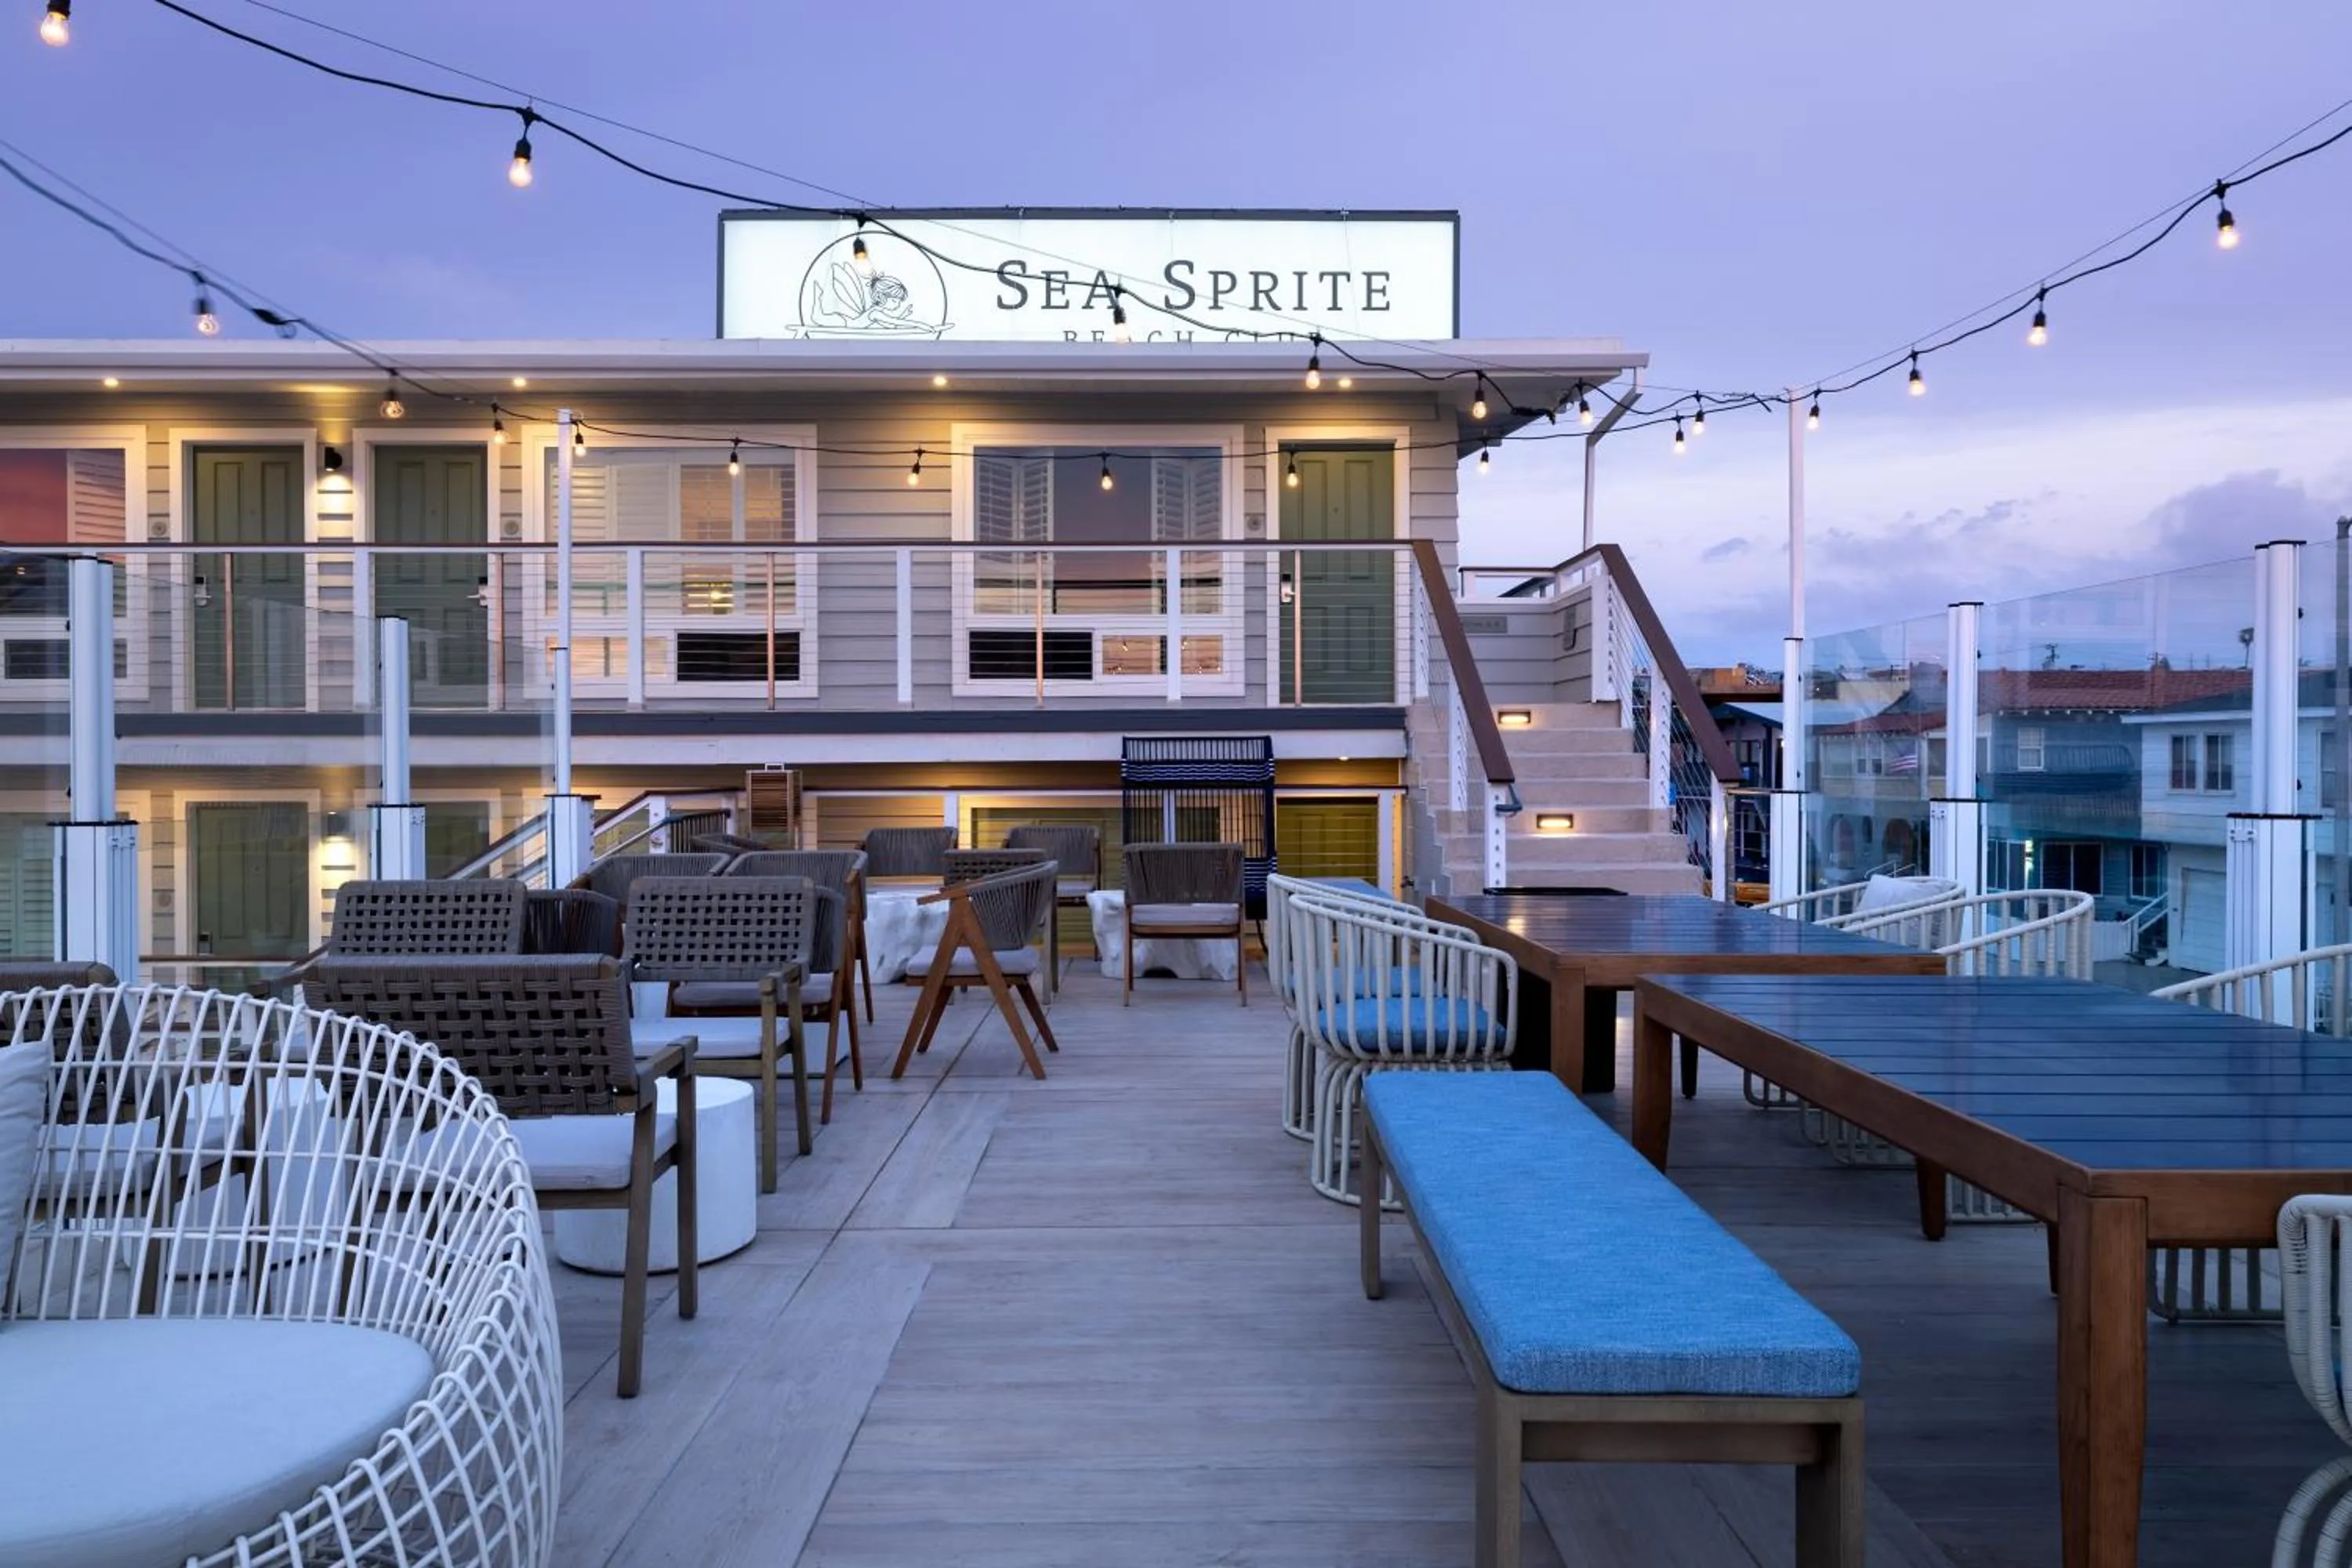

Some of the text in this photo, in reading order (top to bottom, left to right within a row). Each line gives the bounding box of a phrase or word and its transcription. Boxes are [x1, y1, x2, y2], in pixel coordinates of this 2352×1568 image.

[996, 260, 1390, 310] SEA SPRITE
[1063, 330, 1194, 343] BECH
